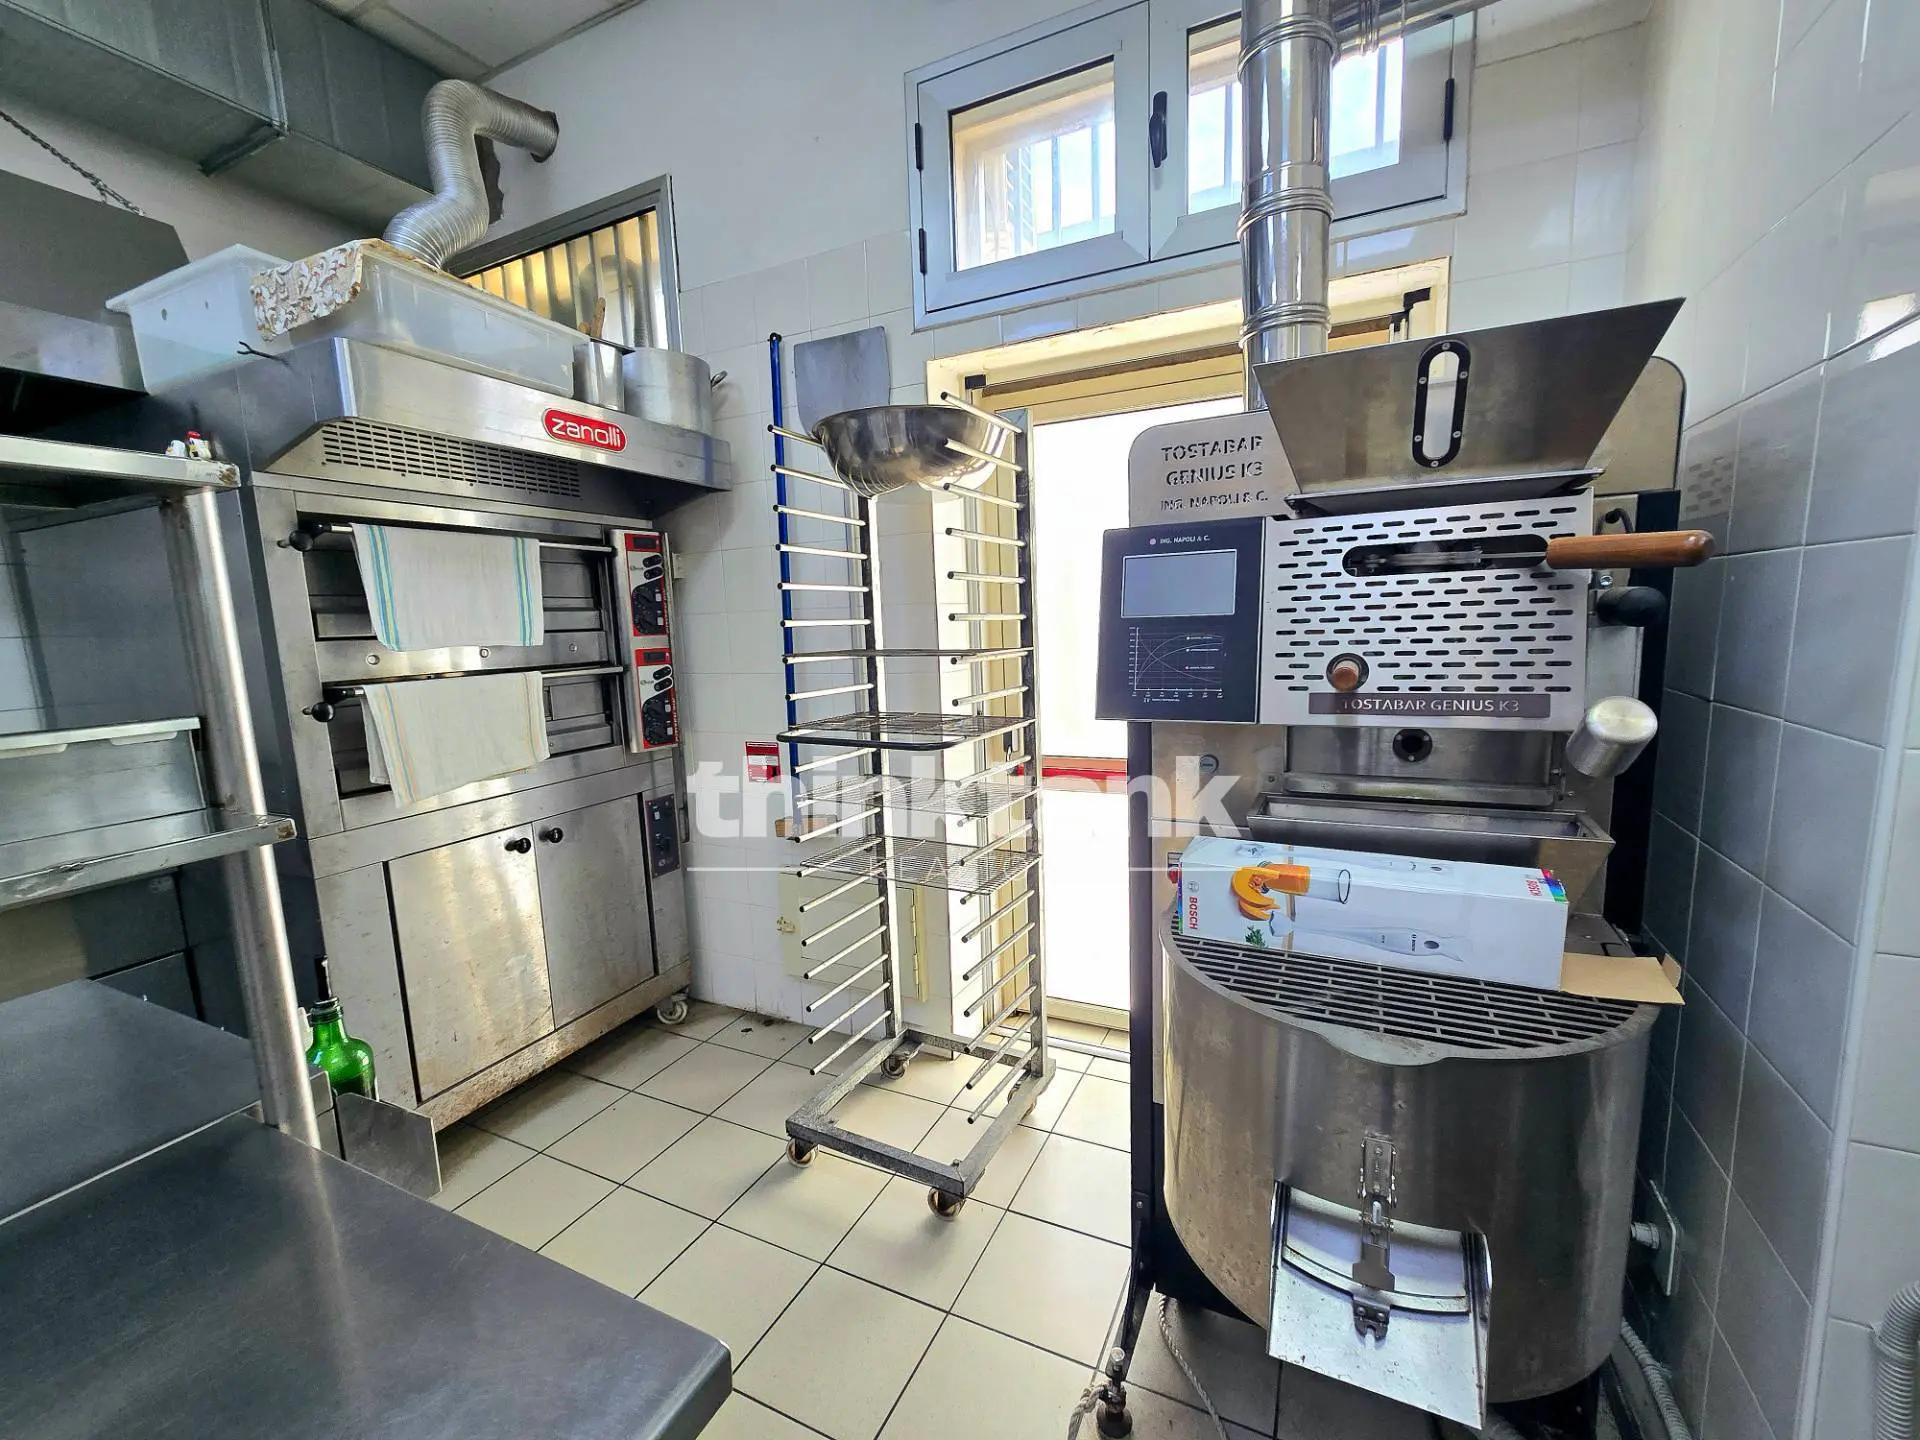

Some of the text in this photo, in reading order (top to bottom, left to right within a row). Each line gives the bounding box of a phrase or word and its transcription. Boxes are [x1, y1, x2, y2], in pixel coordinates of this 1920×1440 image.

[551, 417, 621, 447] zanolli
[1161, 436, 1263, 461] TOSTABAR
[1166, 464, 1235, 486] GENIUS
[1342, 698, 1521, 713] TOSTABAR GENIUS K3
[1188, 896, 1199, 930] BOSCH
